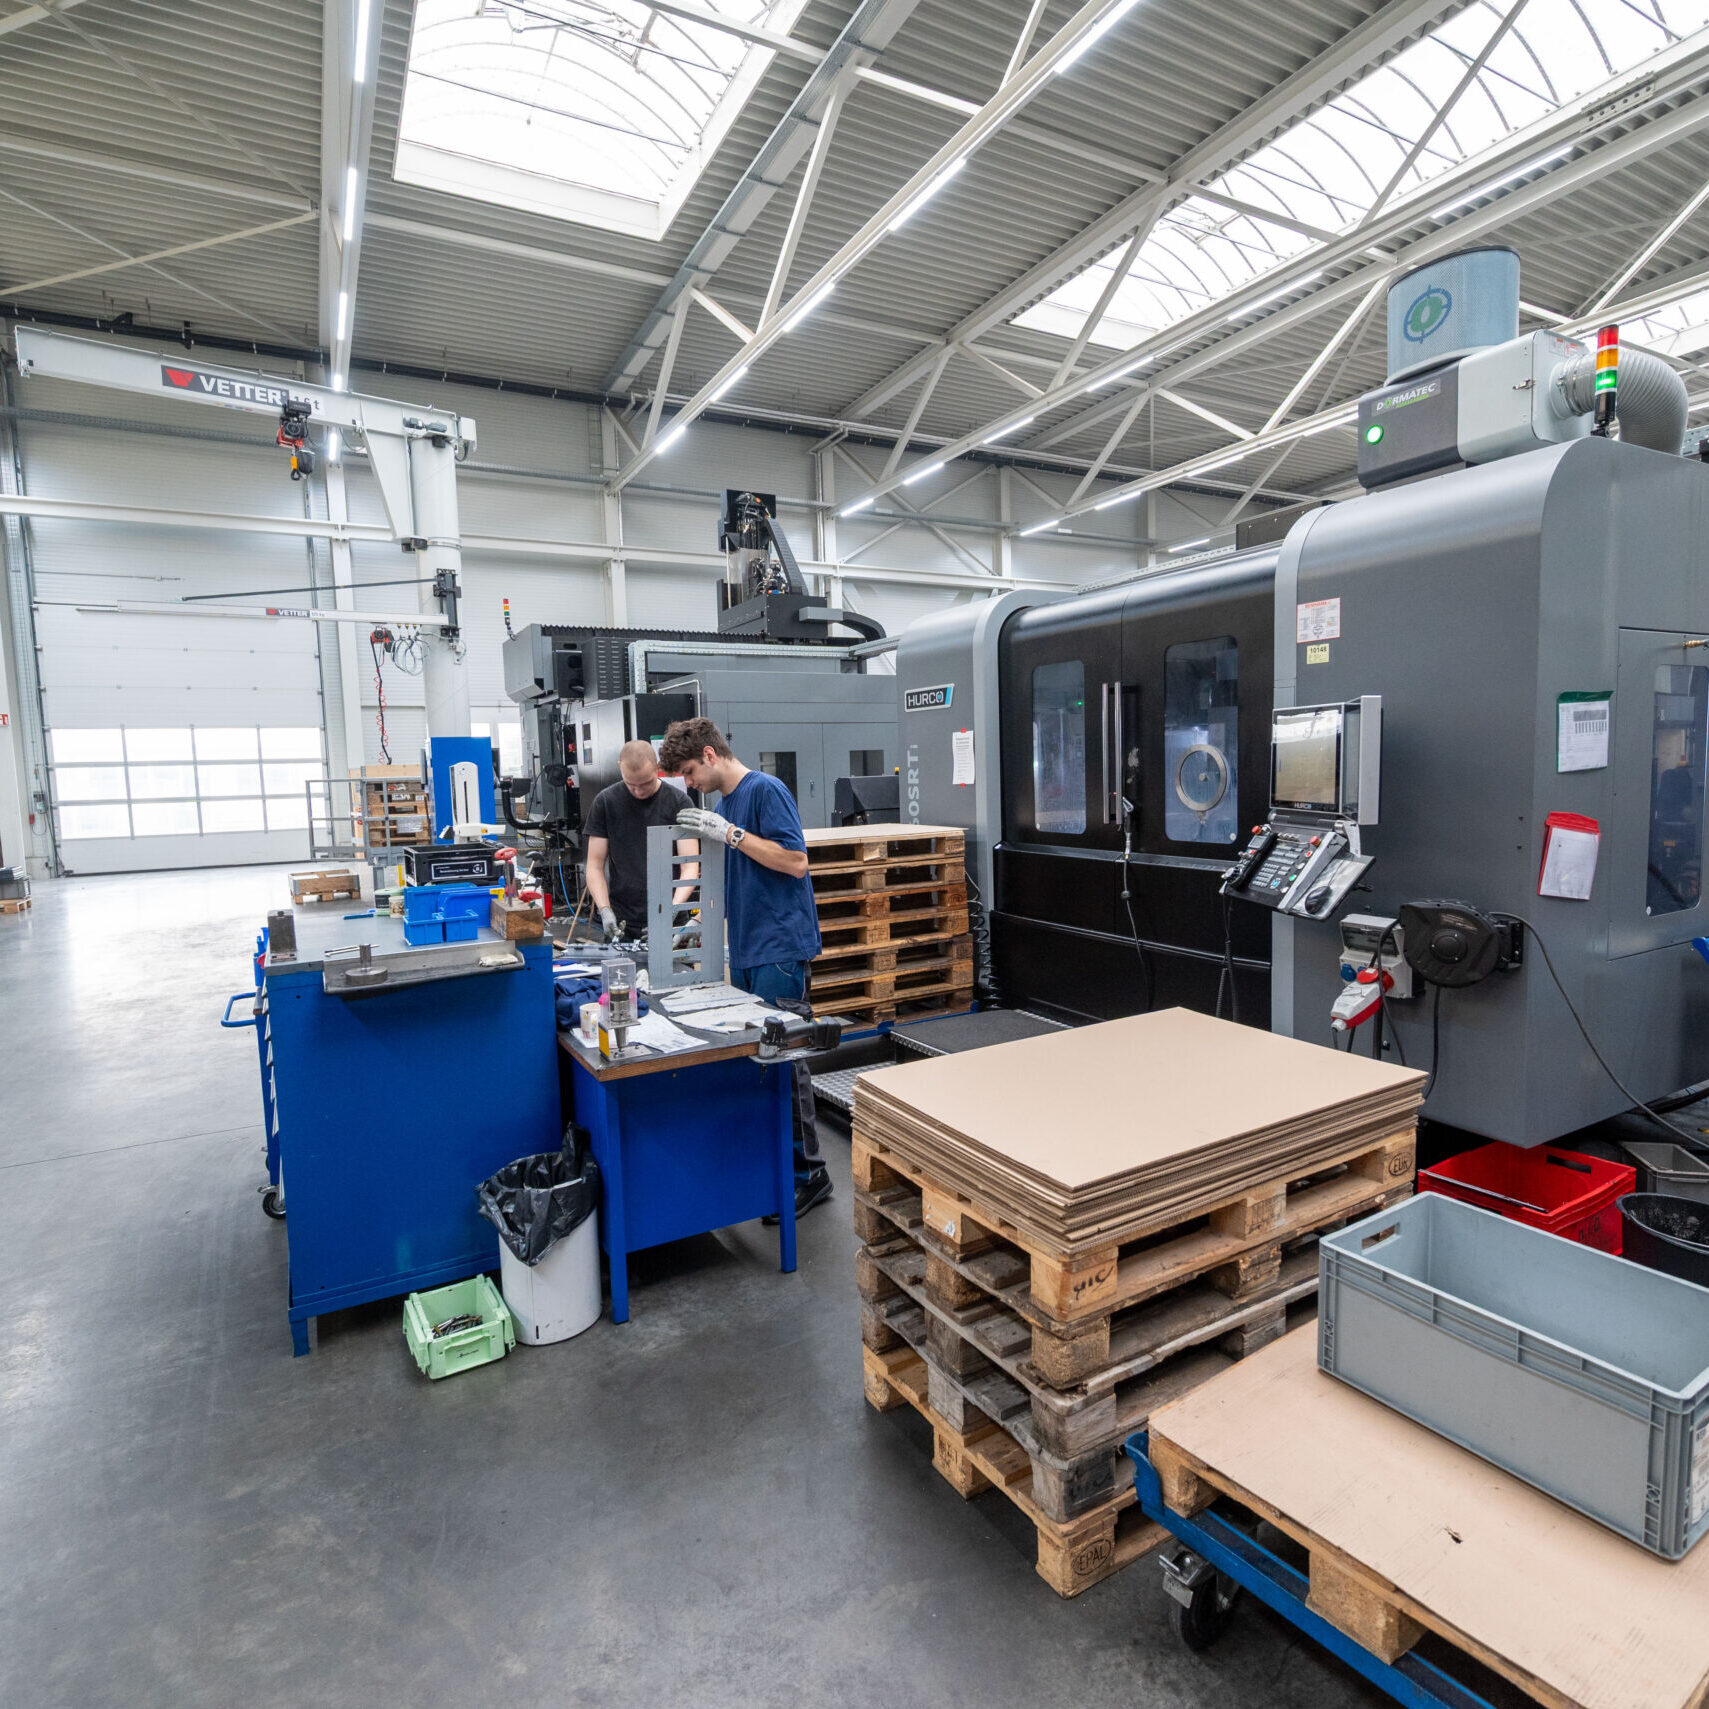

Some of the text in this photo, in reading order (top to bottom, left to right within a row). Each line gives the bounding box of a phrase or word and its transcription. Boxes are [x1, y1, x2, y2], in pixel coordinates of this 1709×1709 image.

[199, 374, 282, 405] VETTER
[278, 609, 308, 617] VETTER
[908, 690, 944, 707] HURCO
[1078, 1545, 1108, 1571] EPAL
